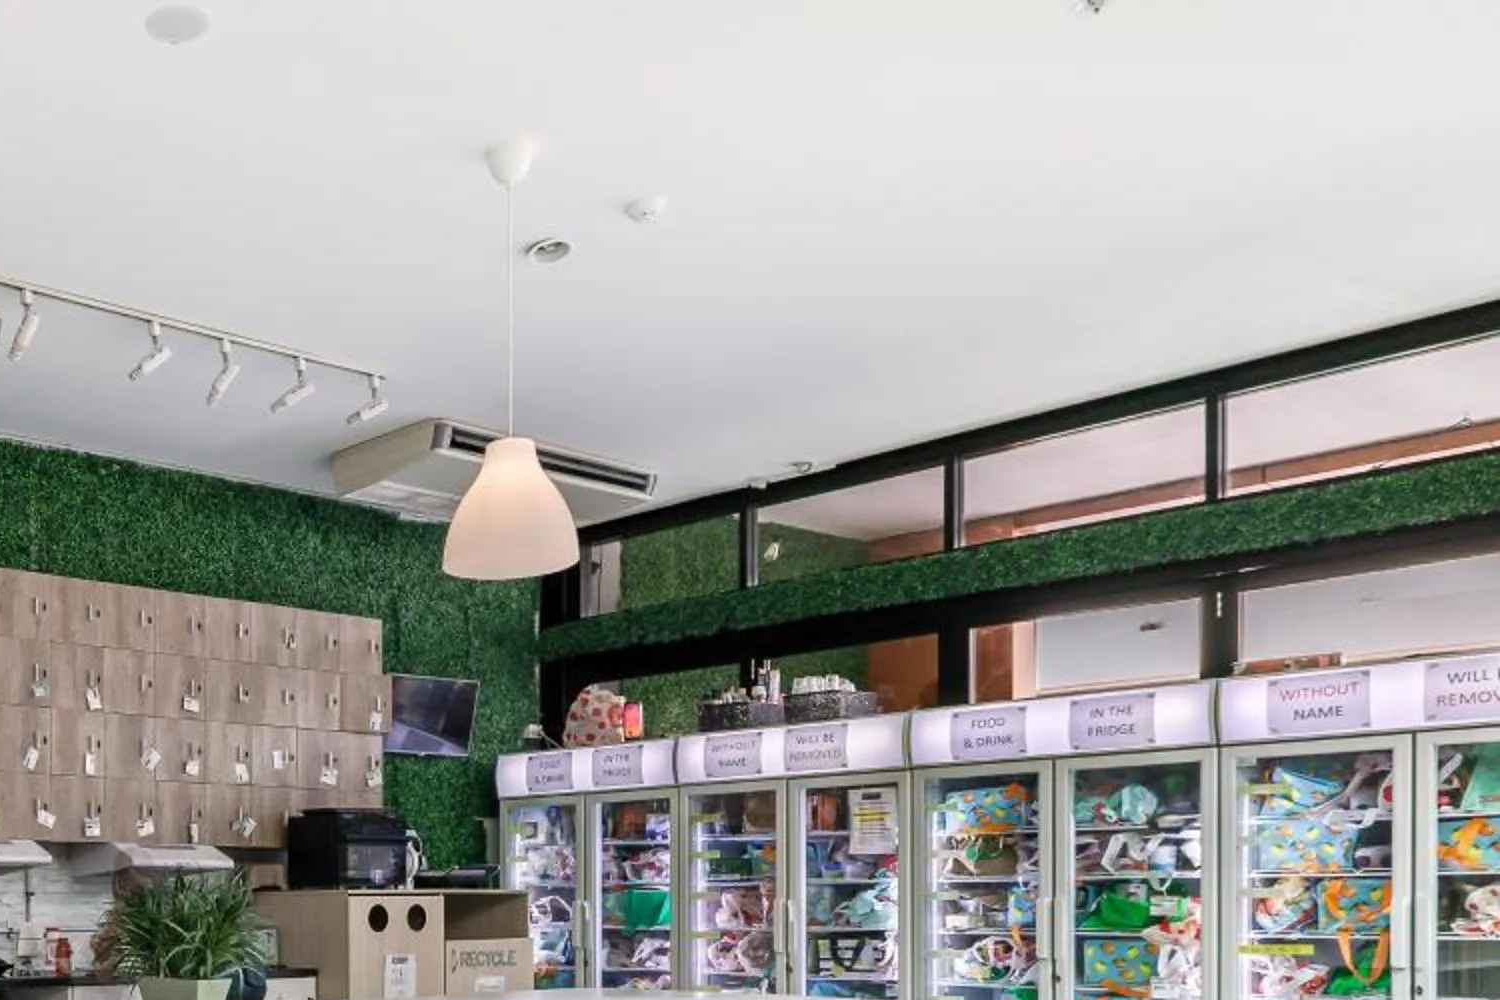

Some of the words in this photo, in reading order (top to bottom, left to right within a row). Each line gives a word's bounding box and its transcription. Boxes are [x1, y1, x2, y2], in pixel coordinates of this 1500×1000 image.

[1446, 668, 1491, 685] WILL
[1278, 681, 1361, 702] WITHOUT
[1108, 704, 1133, 717] THE
[1293, 705, 1344, 721] NAME
[971, 717, 1005, 729] FOOD
[1087, 723, 1137, 738] FRIDGE
[963, 738, 974, 749] &
[975, 734, 1014, 747] DRINK
[459, 950, 517, 968] RECYCLE
